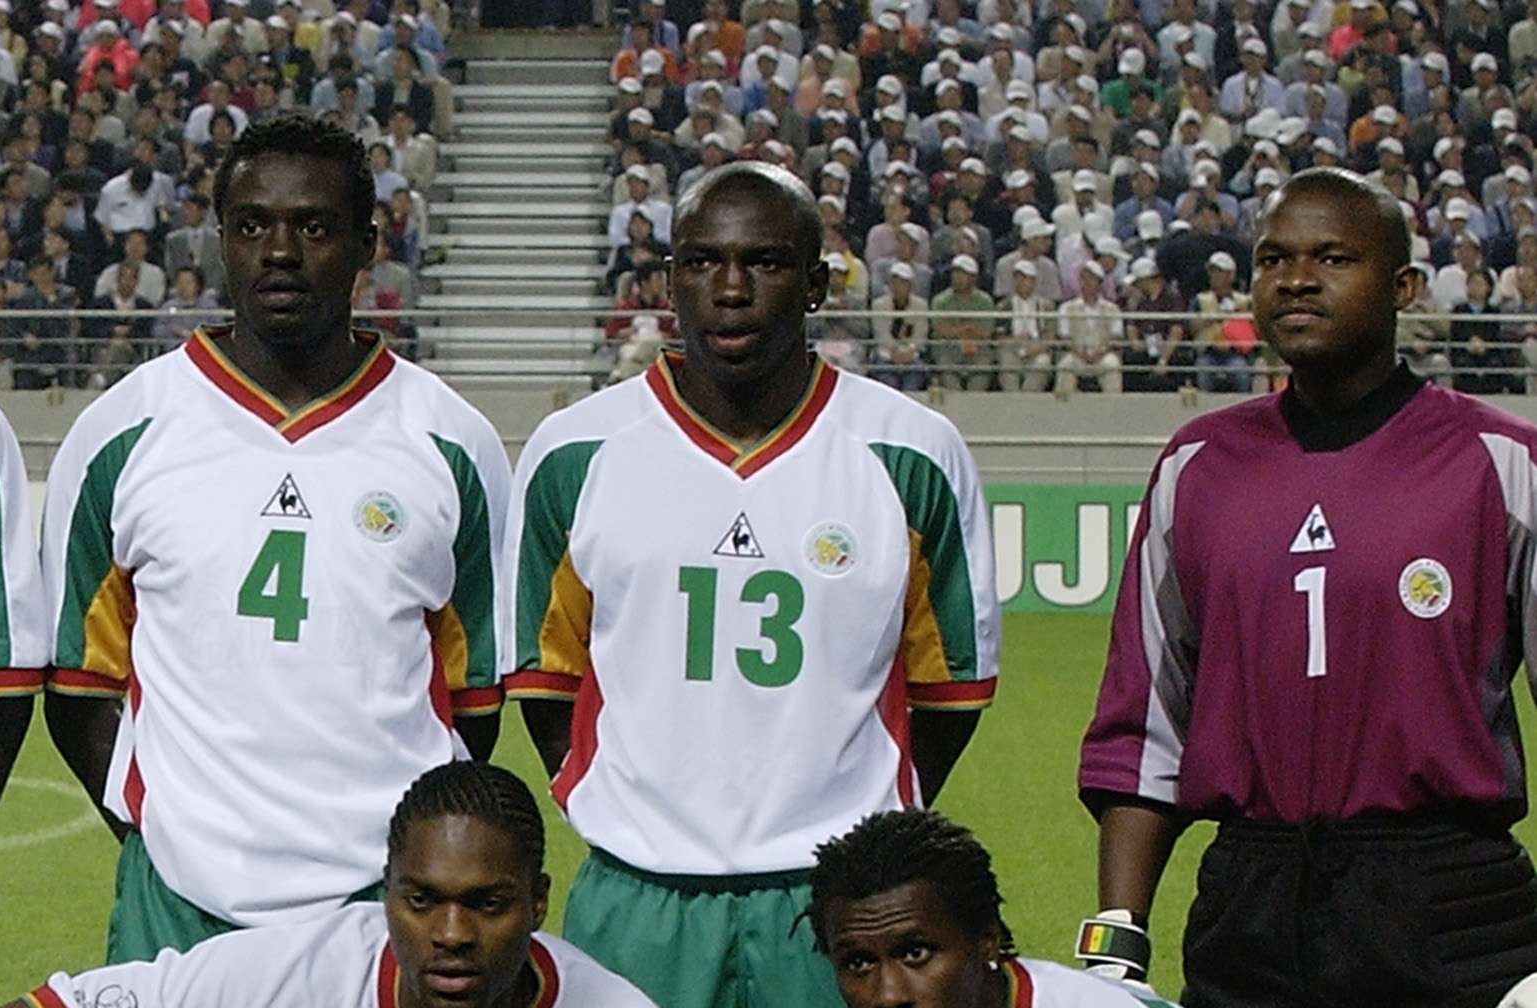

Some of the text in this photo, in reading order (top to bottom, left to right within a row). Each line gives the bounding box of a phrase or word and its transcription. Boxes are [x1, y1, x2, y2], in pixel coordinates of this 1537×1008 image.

[237, 529, 309, 642] 4
[677, 566, 805, 689] 13
[1294, 566, 1327, 677] 1
